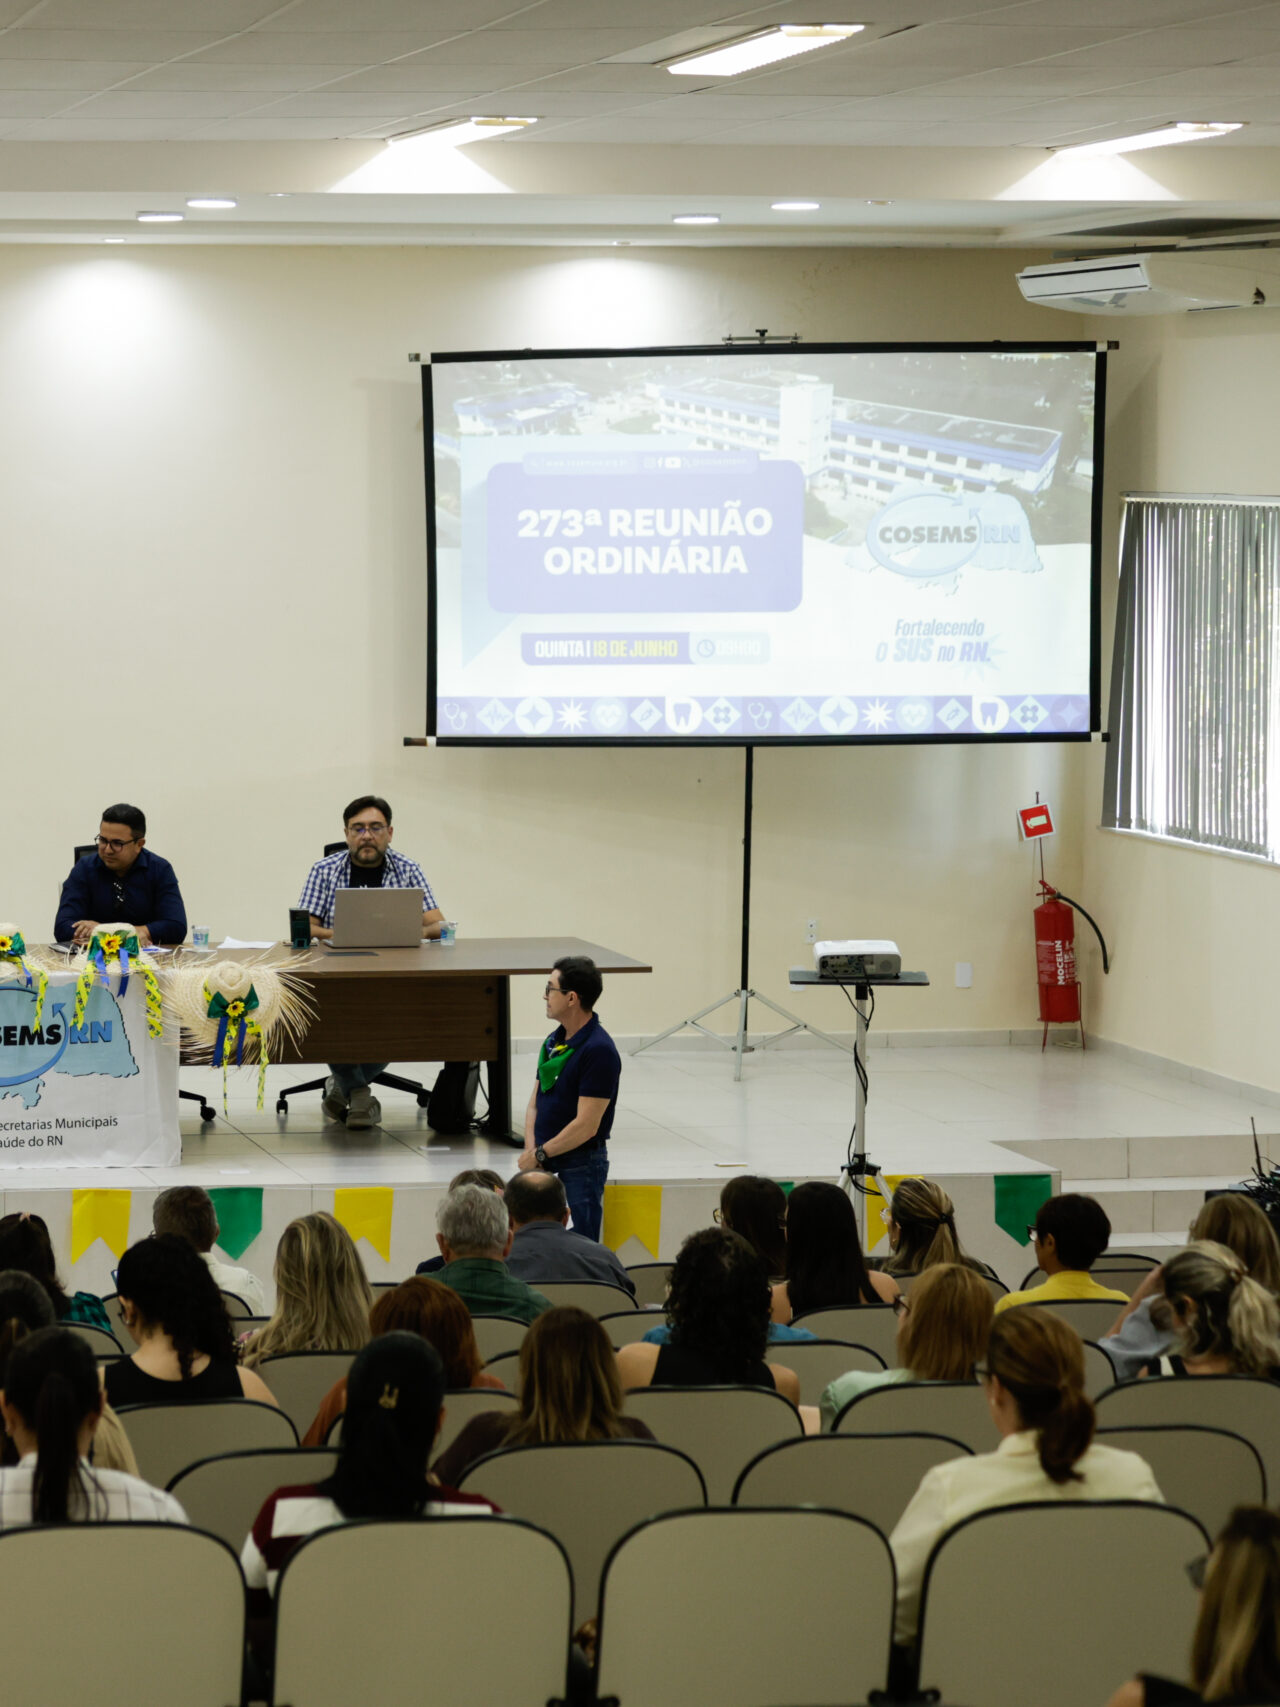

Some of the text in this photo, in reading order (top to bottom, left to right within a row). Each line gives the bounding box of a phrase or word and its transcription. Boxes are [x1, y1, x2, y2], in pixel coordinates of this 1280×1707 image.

[517, 500, 773, 537] 273ª REUNIÃO
[878, 524, 1021, 544] COSEMS RN
[543, 539, 749, 575] ORDINÁRIA
[894, 618, 985, 637] Fortalecendo
[535, 640, 585, 659] QUINTA
[593, 640, 608, 658] 18
[610, 640, 627, 658] DE
[629, 639, 678, 658] JUNHO
[893, 637, 934, 662] SUS
[937, 645, 955, 662] no
[958, 641, 991, 662] RN.
[1055, 940, 1065, 985] MOCELIN
[69, 1020, 113, 1045] RN
[55, 1116, 119, 1130] Municipais
[28, 1136, 44, 1147] do
[47, 1135, 63, 1147] RN
